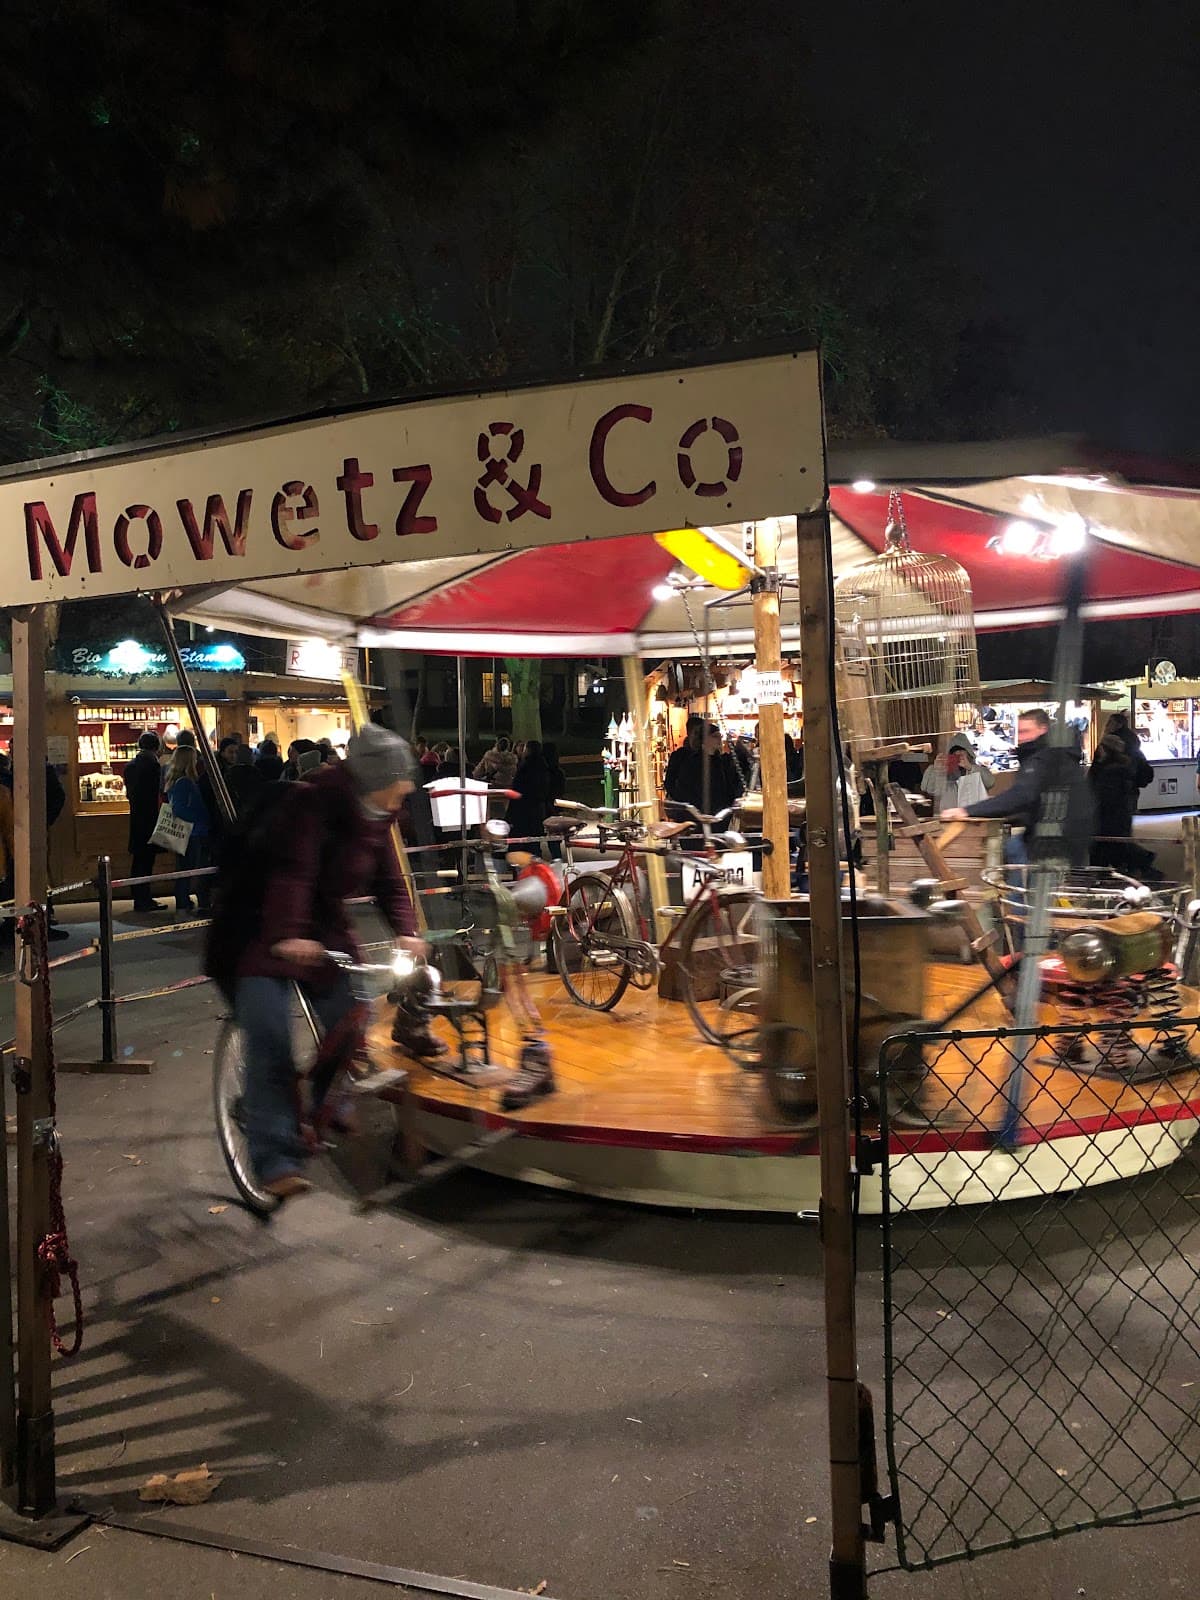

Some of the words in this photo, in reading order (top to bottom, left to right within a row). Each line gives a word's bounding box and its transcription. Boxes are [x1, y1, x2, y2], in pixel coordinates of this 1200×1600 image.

[23, 457, 438, 581] Mowetz
[474, 421, 552, 523] &
[588, 403, 744, 507] Co
[71, 647, 103, 664] Bio
